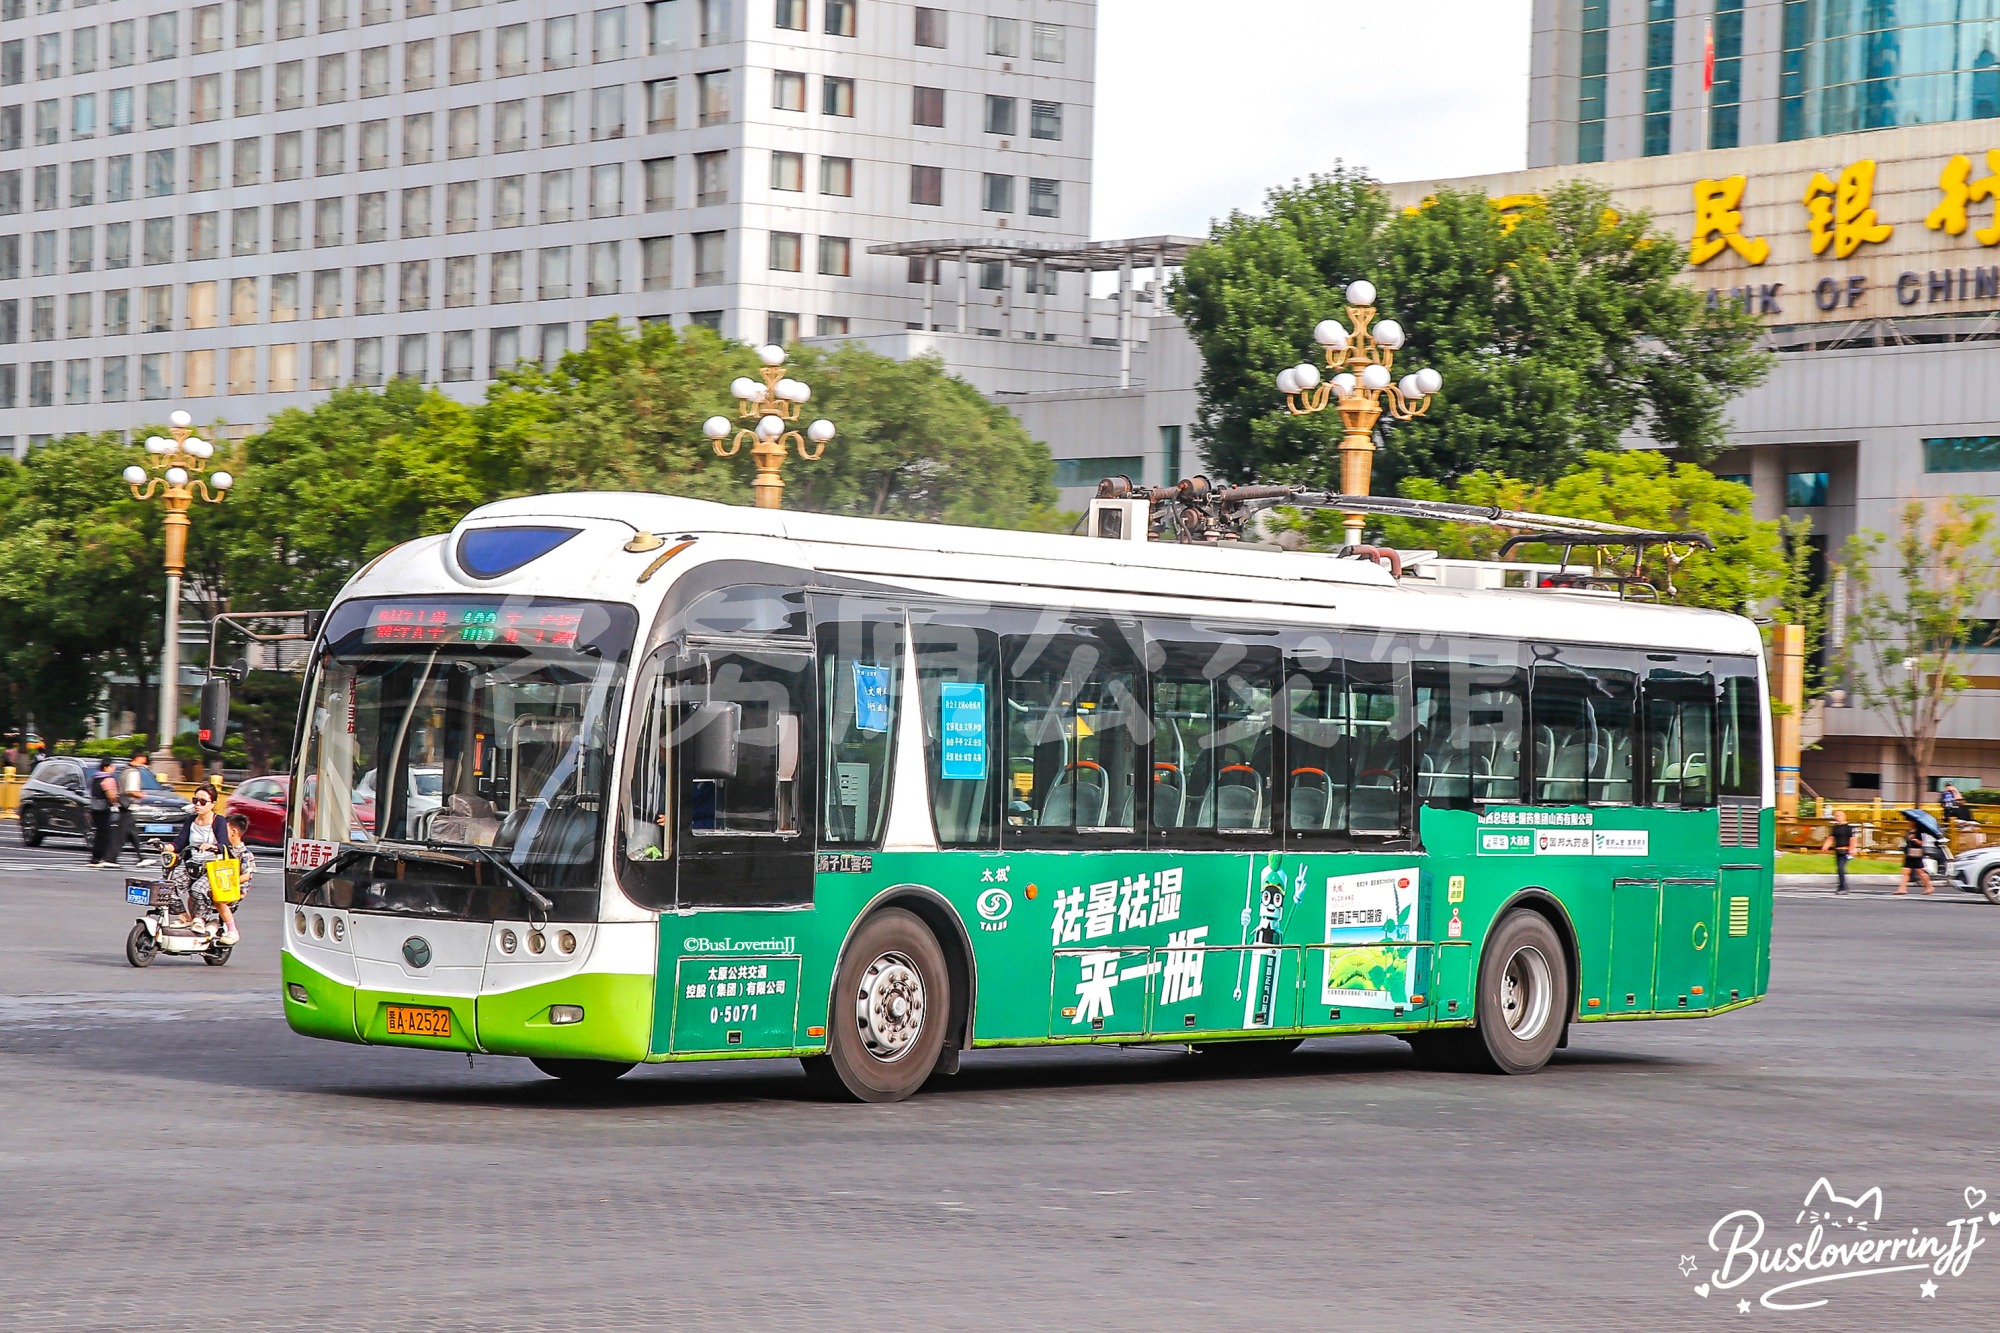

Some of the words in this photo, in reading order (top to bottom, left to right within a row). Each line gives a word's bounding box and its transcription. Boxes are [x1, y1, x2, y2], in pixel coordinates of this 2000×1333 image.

[1705, 282, 1784, 314] ANK
[1815, 274, 1868, 311] OF
[290, 841, 333, 868] 投币壹元
[1051, 867, 1183, 946] 祛暑祛湿
[707, 964, 768, 981] 太原公共交通
[1071, 925, 1209, 1024] 来一瓶
[685, 980, 786, 999] 控股（集团）有限公司
